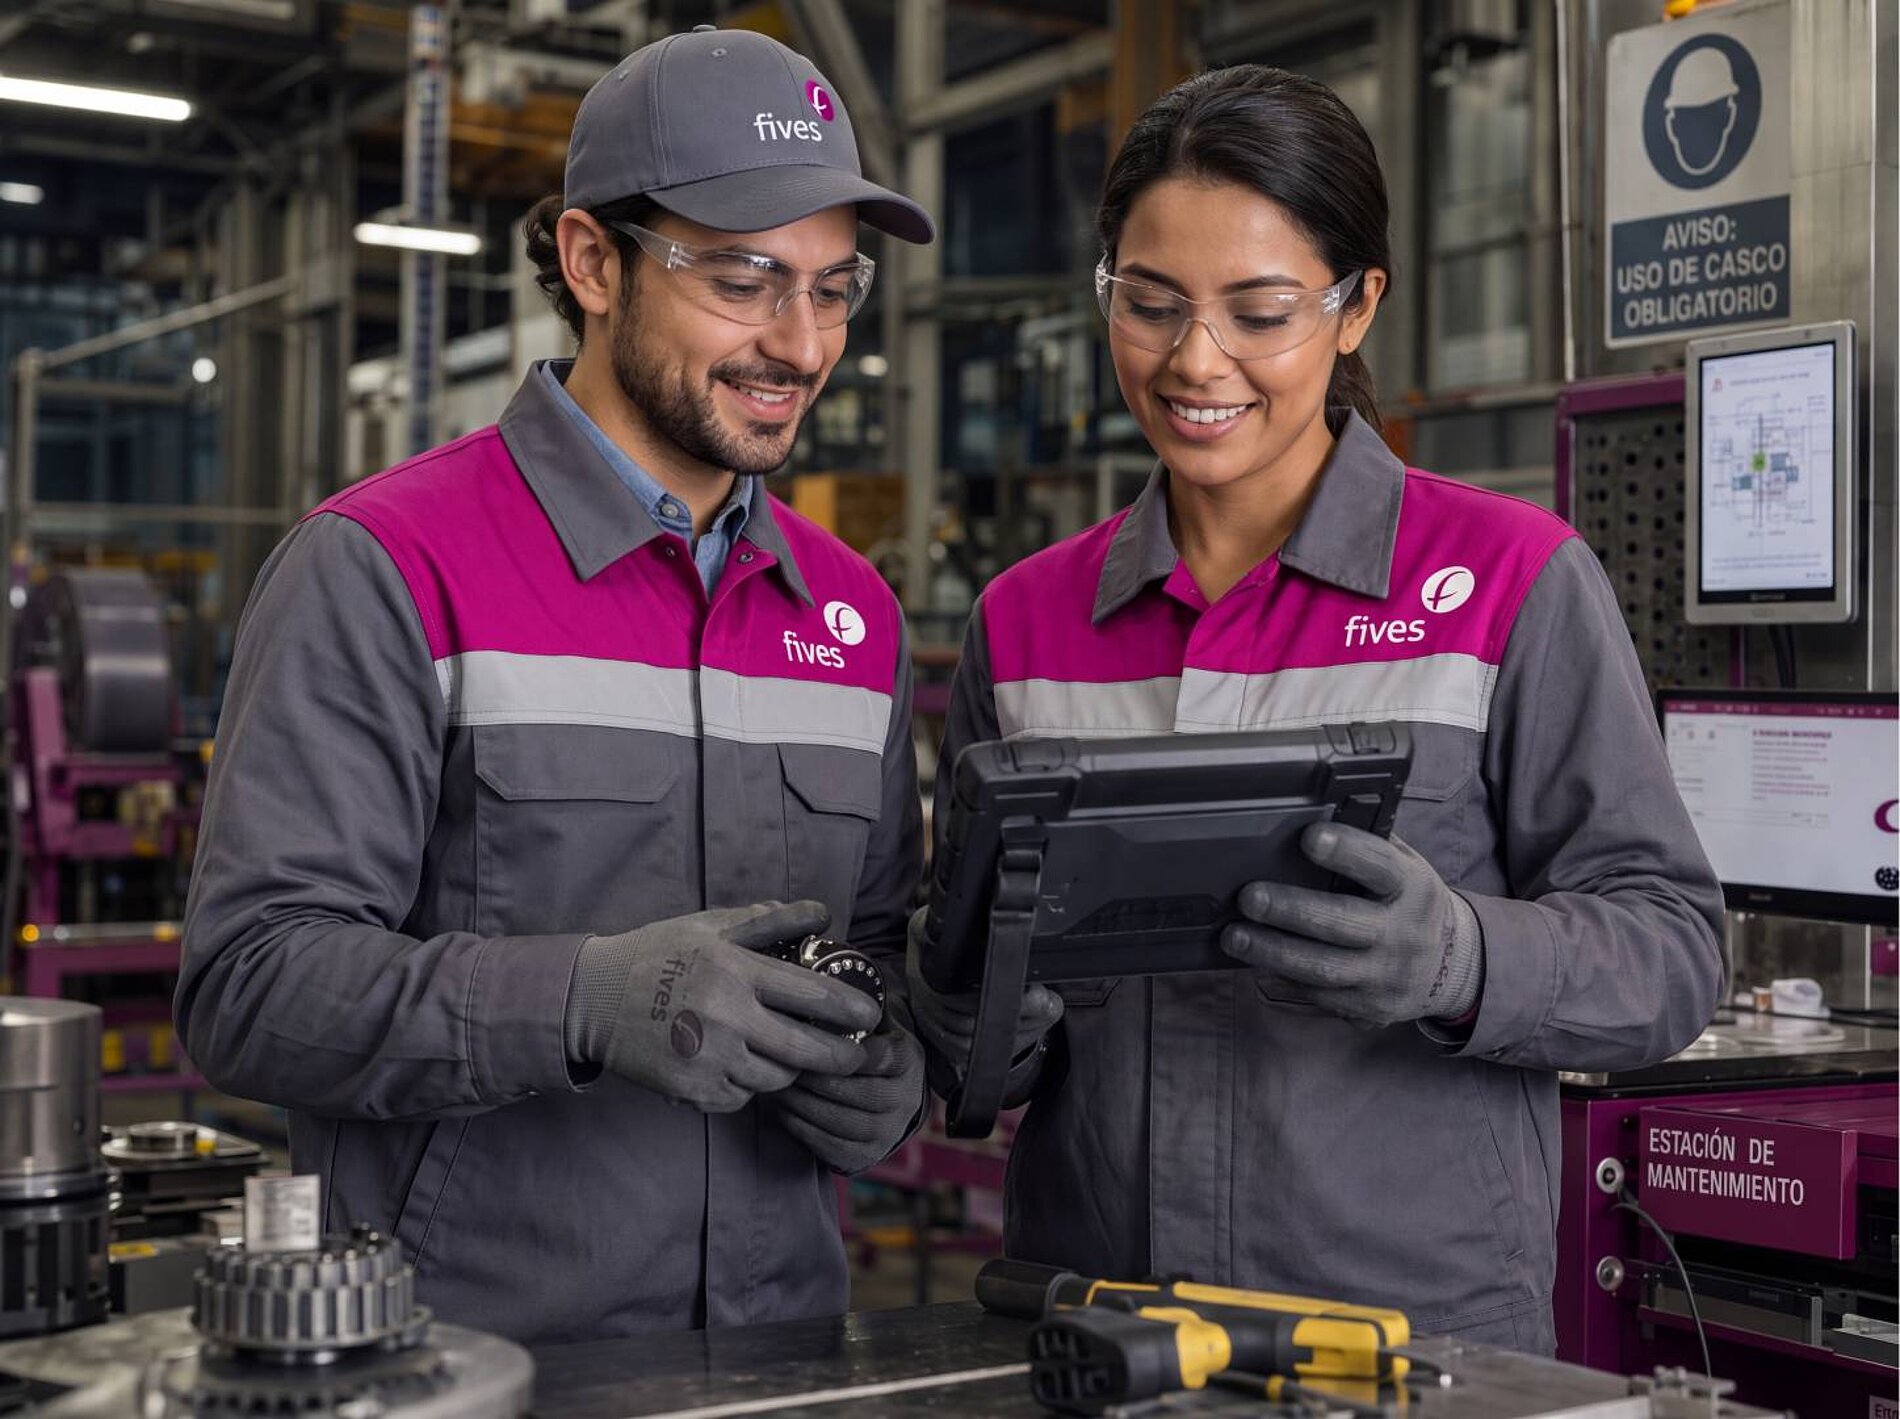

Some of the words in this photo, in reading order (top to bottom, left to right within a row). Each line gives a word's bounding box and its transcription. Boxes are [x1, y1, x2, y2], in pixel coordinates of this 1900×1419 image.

[753, 112, 822, 141] fives
[1662, 214, 1737, 251] AVISO:
[1617, 261, 1663, 294] USO
[1668, 255, 1699, 286] DE
[1705, 243, 1786, 281] CASCO
[1624, 282, 1777, 329] OBLIGATORIO
[783, 630, 845, 669] fives
[1344, 615, 1425, 647] fives
[651, 959, 686, 1022] fives
[1649, 1127, 1735, 1162] ESTACIÓN
[1749, 1138, 1775, 1166] DE
[1647, 1162, 1804, 1206] MANTENIMIENTO
